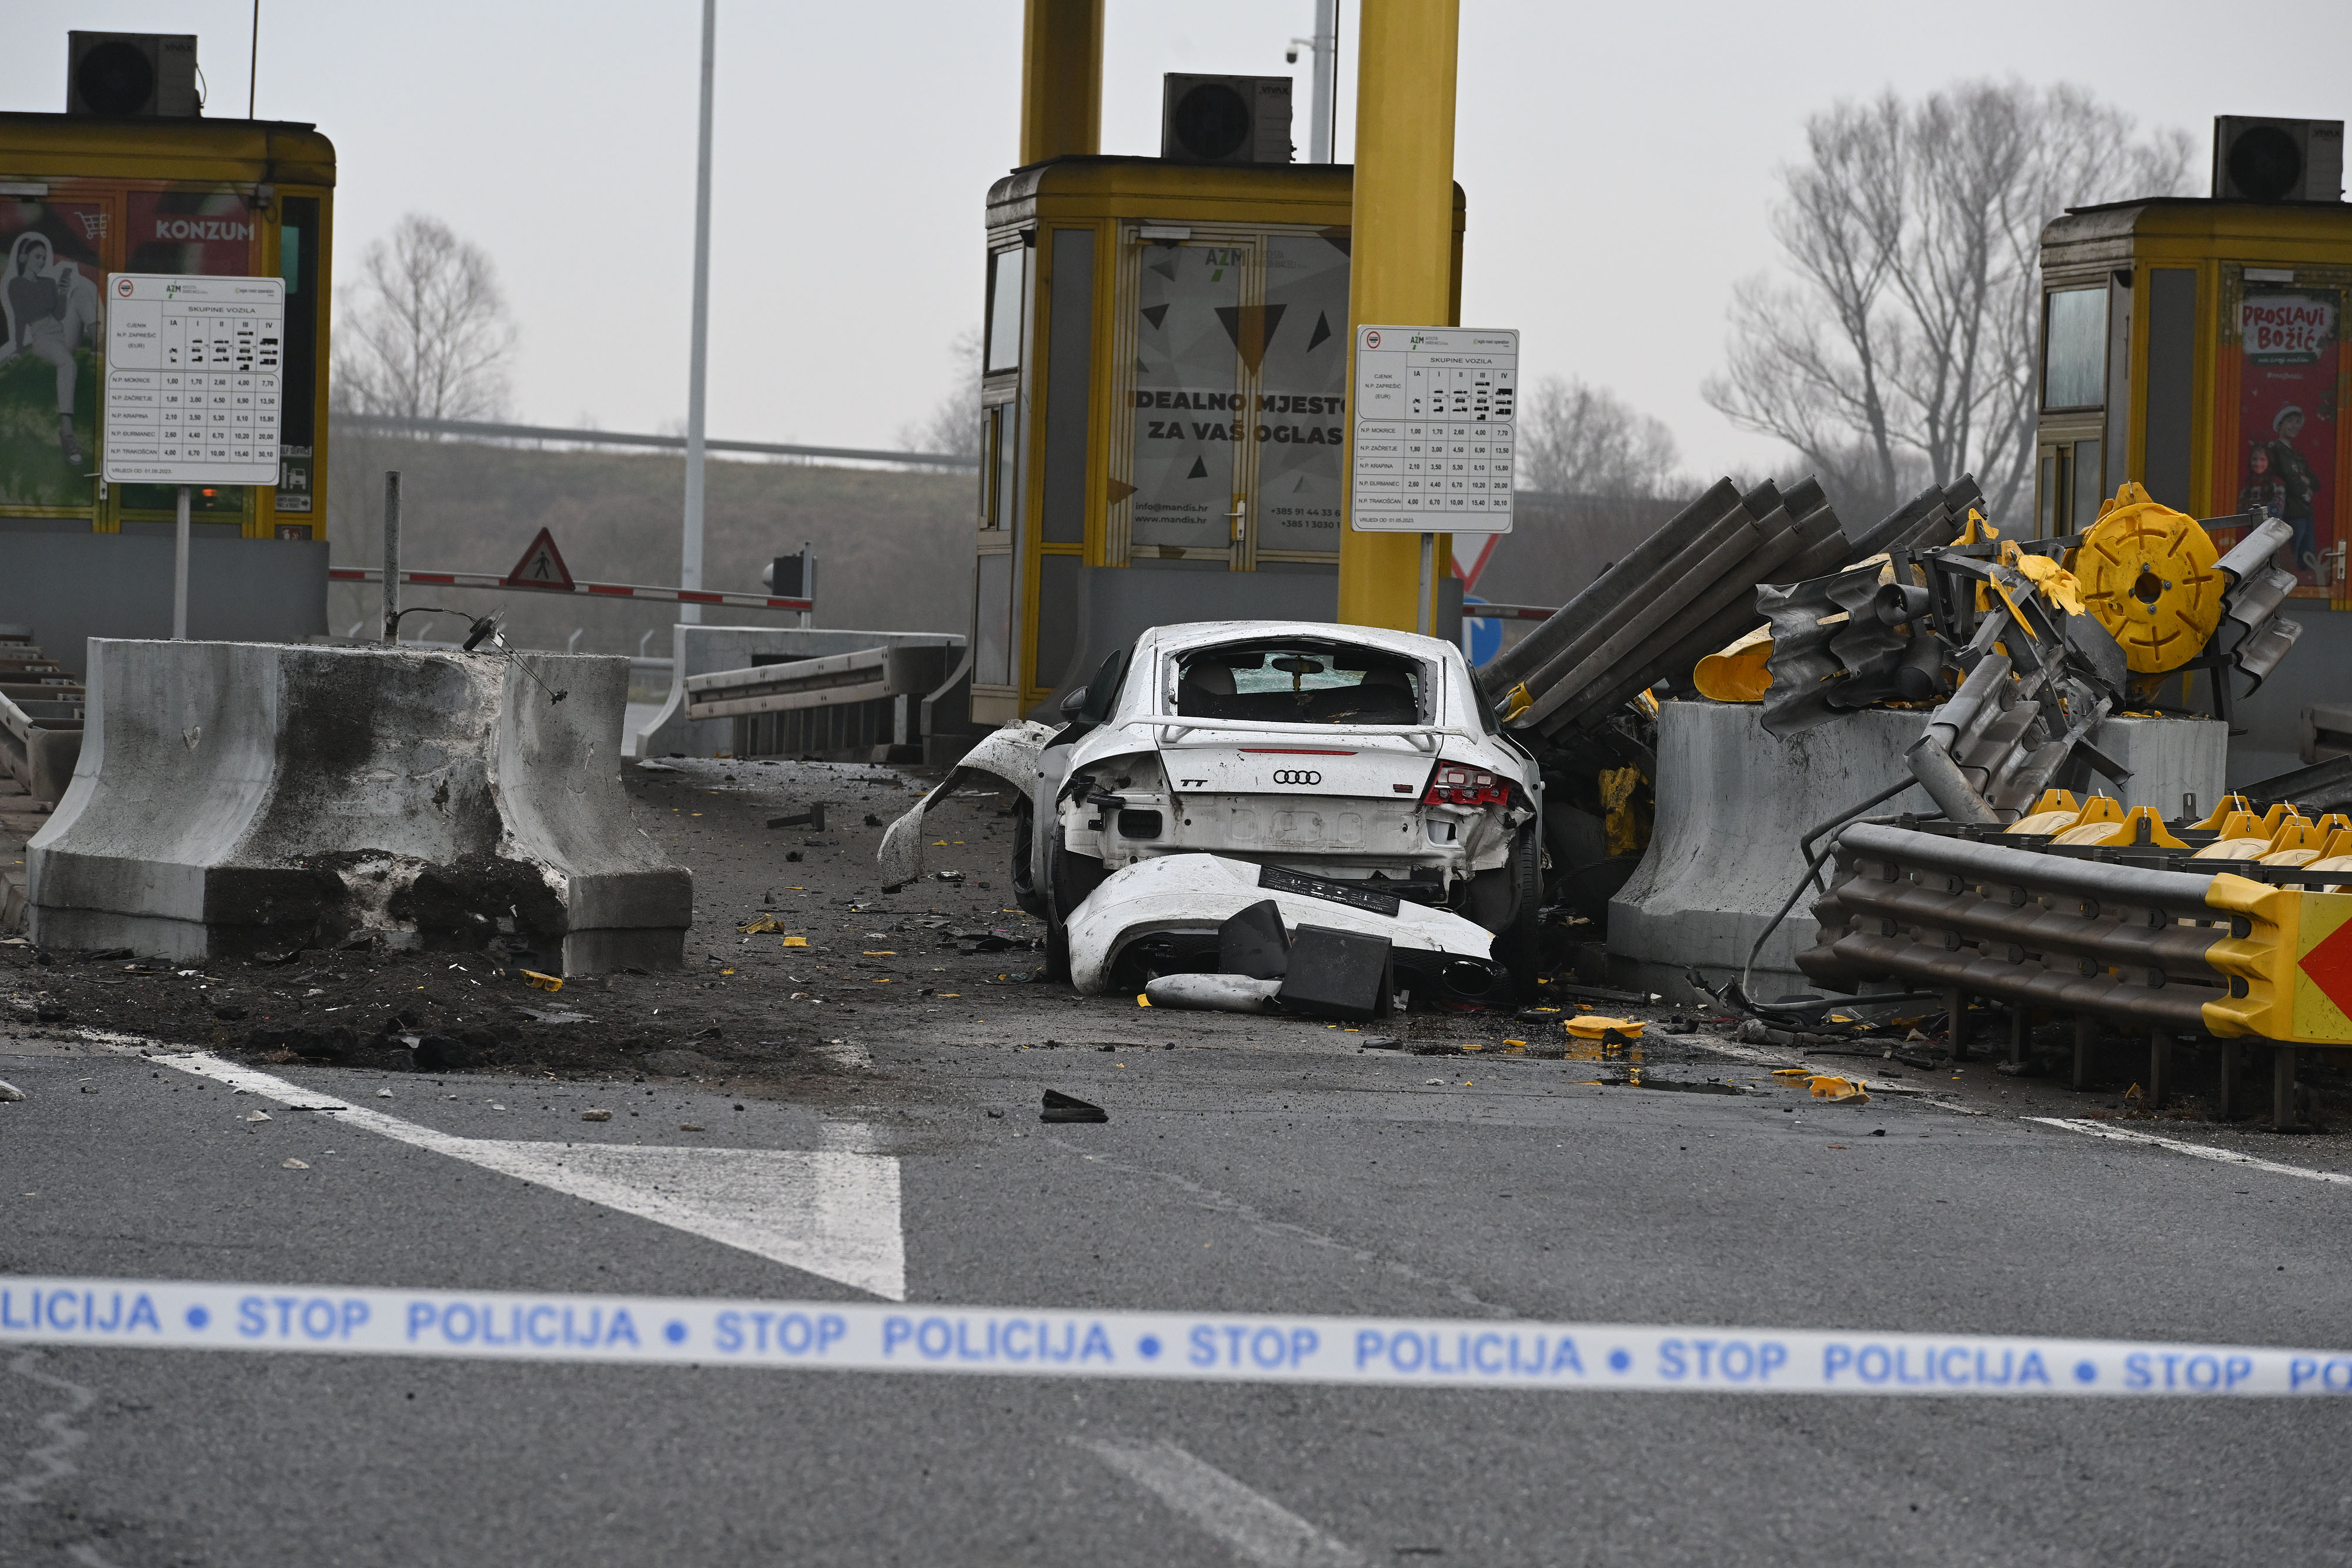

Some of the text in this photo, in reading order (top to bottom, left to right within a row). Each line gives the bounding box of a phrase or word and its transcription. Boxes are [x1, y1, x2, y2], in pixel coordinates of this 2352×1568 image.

[156, 220, 255, 241] KONZUM
[166, 285, 181, 293] AZM
[1128, 390, 1247, 411] IDEALNO
[1148, 419, 1343, 445] ZA VAŠ OGLAS
[280, 447, 288, 455] ELF
[1135, 502, 1208, 513] info@mandis.hr
[1271, 508, 1293, 516] +385
[1135, 515, 1207, 524] www.mandis.hr
[1180, 779, 1208, 787] TT
[1274, 884, 1384, 911] PORSCHE ZAGREB JANKOMIR
[238, 1296, 371, 1340] STOP
[406, 1300, 640, 1347] POLICIJA
[714, 1311, 847, 1356] STOP
[881, 1316, 1114, 1363] POLICIJA
[1188, 1325, 1320, 1370] STOP
[1355, 1329, 1585, 1377] POLICIJA
[1658, 1338, 1788, 1382] STOP
[1823, 1343, 2051, 1386] POLICIJA
[2124, 1352, 2253, 1391] STOP
